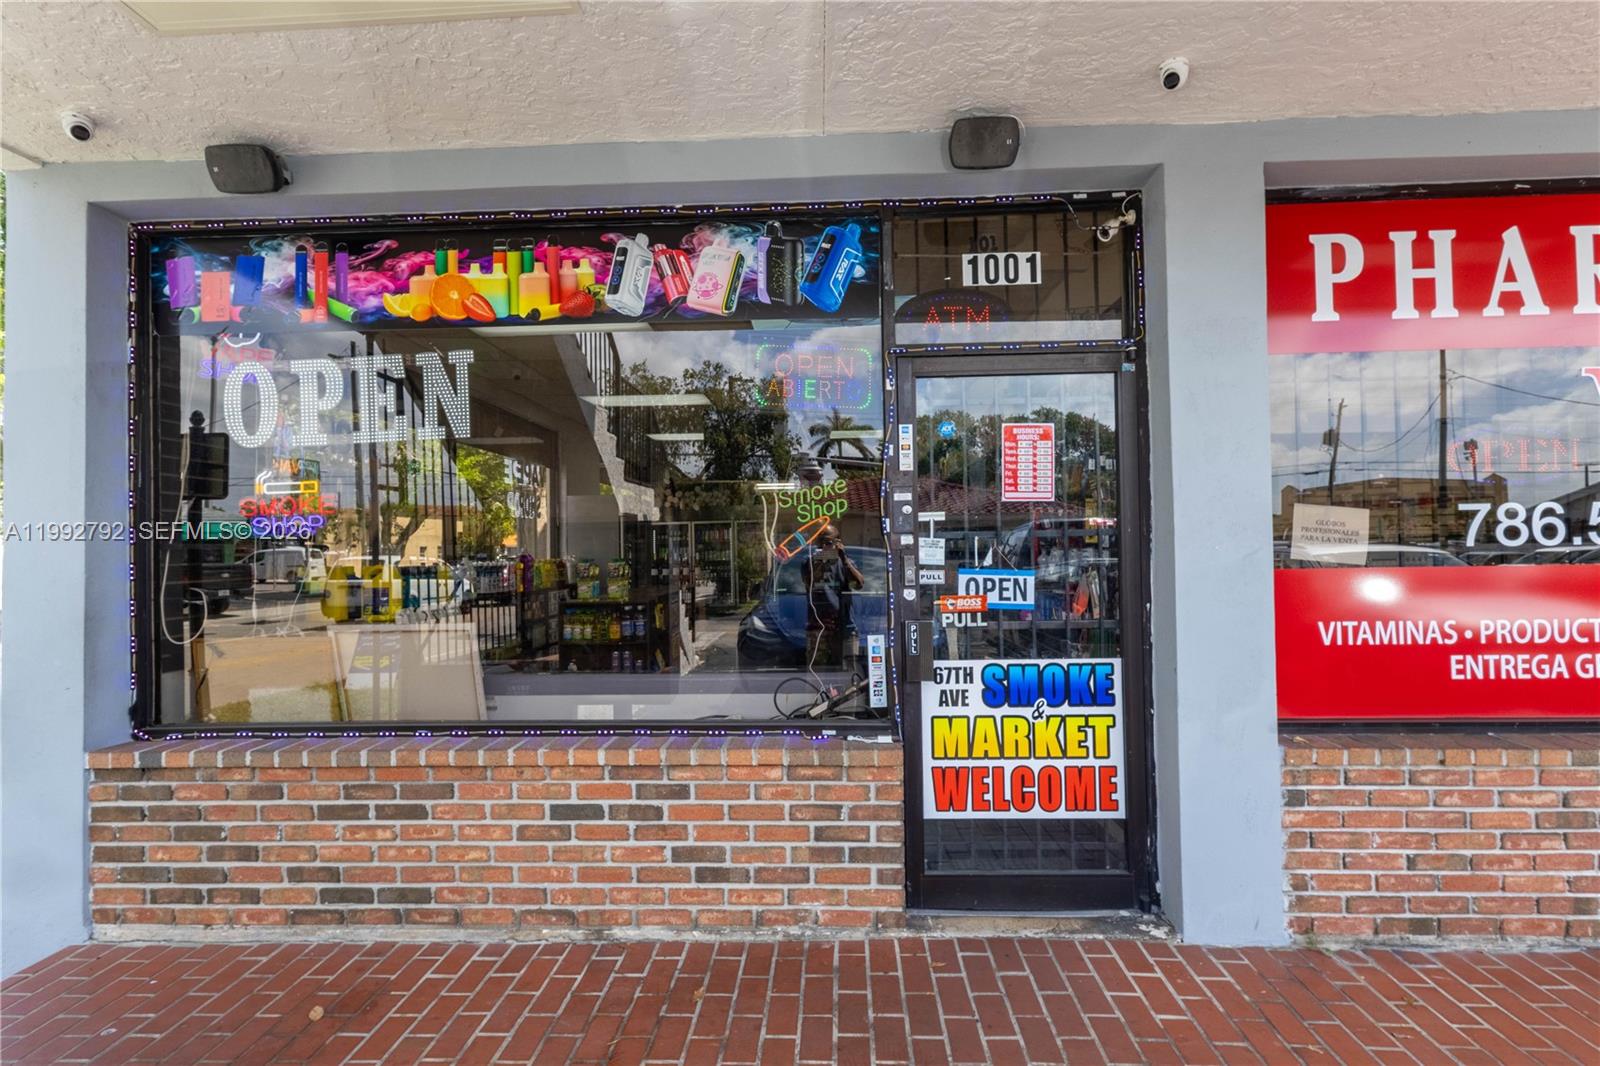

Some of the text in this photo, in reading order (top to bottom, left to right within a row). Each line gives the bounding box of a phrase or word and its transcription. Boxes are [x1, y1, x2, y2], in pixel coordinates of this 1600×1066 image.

[967, 253, 1038, 285] 1001
[923, 305, 991, 331] ATM
[775, 353, 855, 378] OPEN
[223, 350, 475, 449] OPEN
[1447, 436, 1581, 473] OPEN
[239, 492, 337, 519] SMOKE
[779, 478, 848, 509] Smoke
[797, 499, 848, 523] Shop
[252, 514, 325, 537] SHOP
[957, 598, 982, 606] BOSS
[965, 576, 1028, 602] OPEN
[941, 612, 988, 628] PULL
[1318, 619, 1458, 646] VITAMINAS
[1450, 652, 1600, 680] ENTREGA G
[933, 662, 1116, 708] 67TH SMOKE
[938, 689, 969, 707] AVE
[1031, 699, 1046, 721] &
[931, 714, 1116, 760] MARKET
[931, 765, 1119, 812] WELCOME
